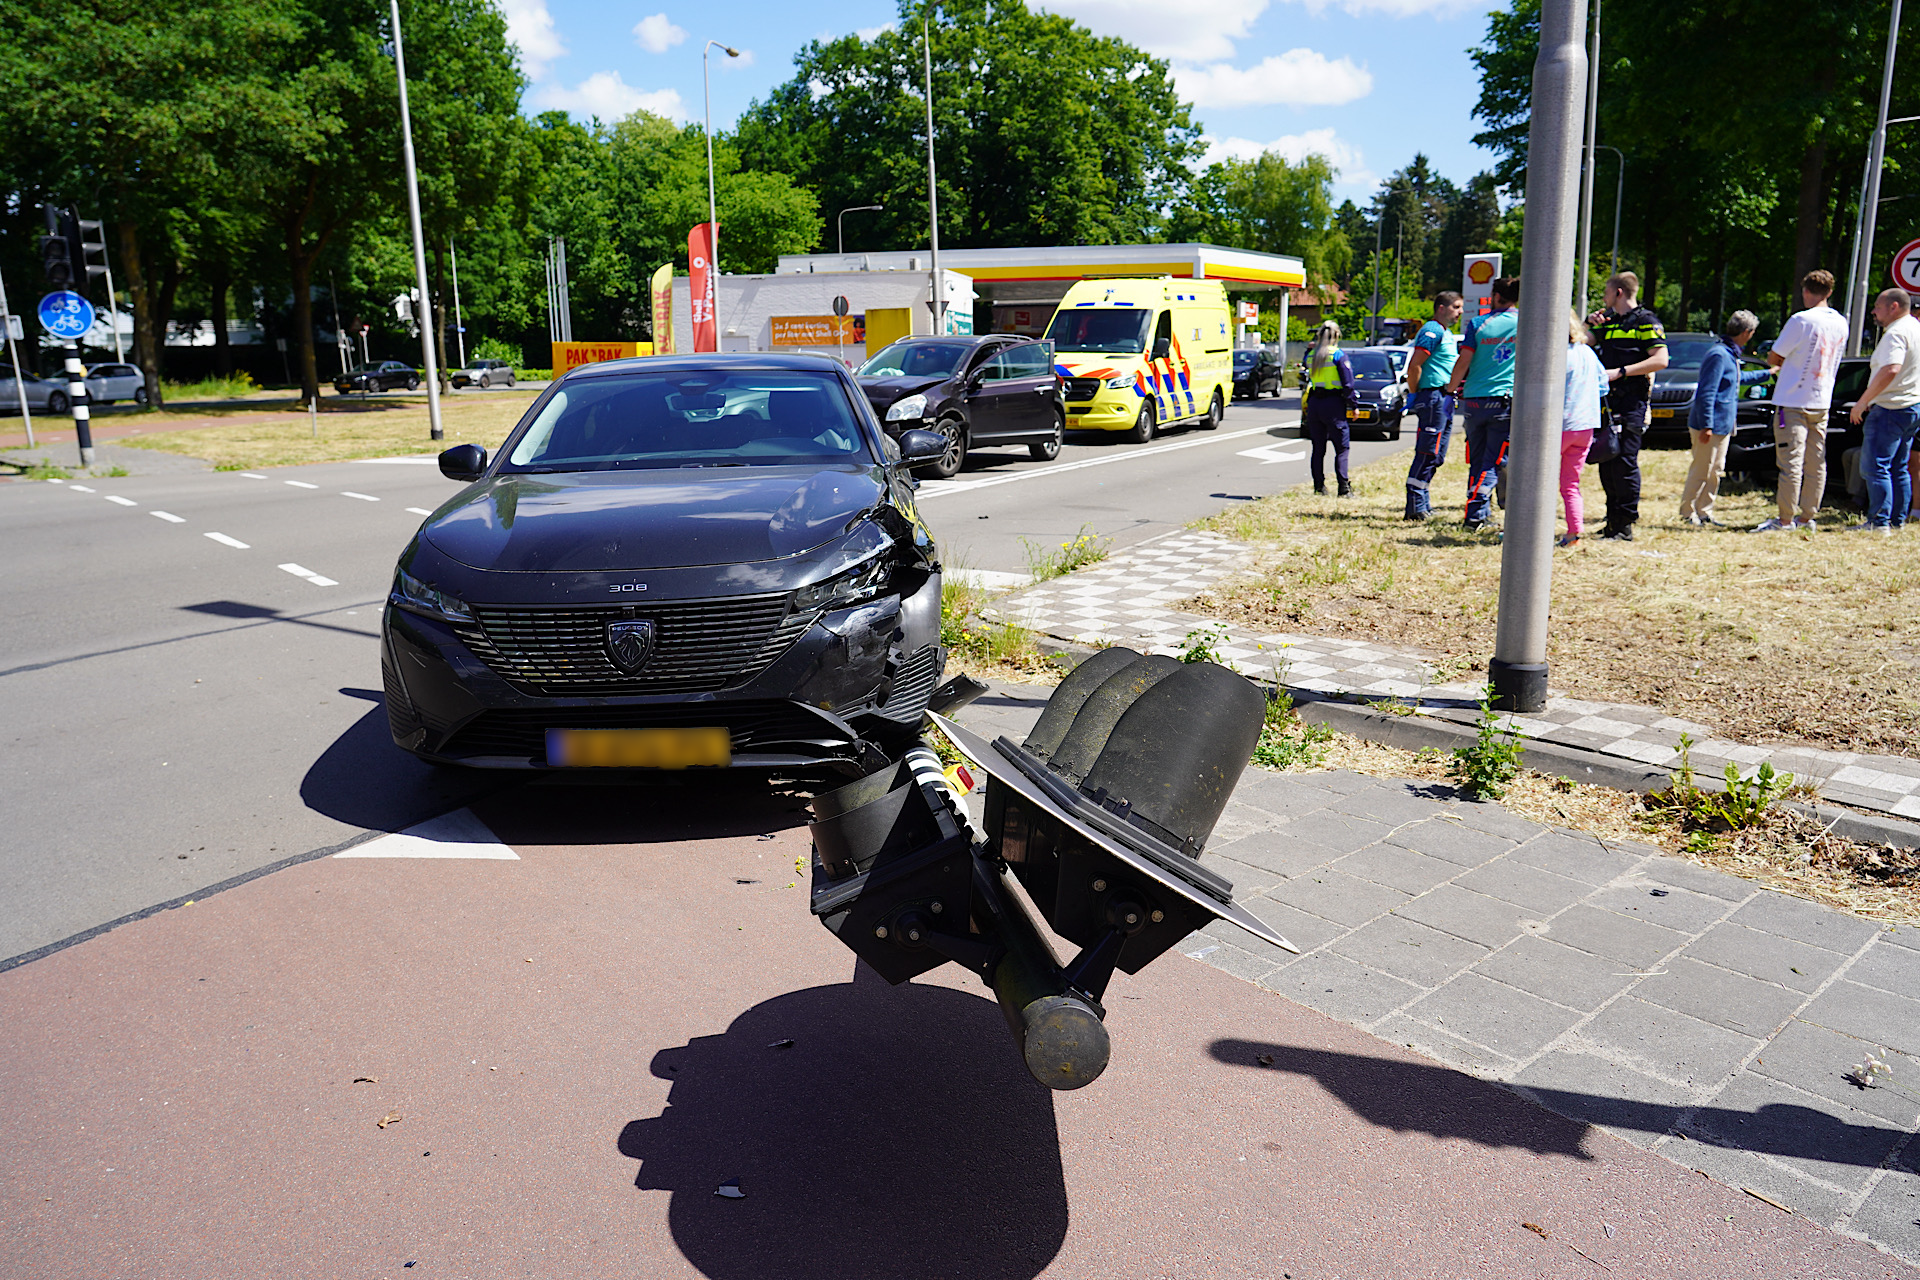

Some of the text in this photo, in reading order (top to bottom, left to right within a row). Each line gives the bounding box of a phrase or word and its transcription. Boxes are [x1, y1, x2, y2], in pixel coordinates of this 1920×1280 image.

[1906, 257, 1920, 278] 7
[702, 262, 714, 323] V-Power
[654, 287, 672, 321] BAK
[693, 299, 703, 323] Shell
[774, 332, 786, 340] per
[786, 331, 800, 339] liter
[815, 330, 832, 338] Shell
[790, 322, 804, 330] cent
[805, 321, 830, 332] korting
[1480, 336, 1517, 346] AMBULA
[566, 348, 589, 365] PAK
[597, 348, 623, 362] BAK
[609, 584, 647, 592] 308
